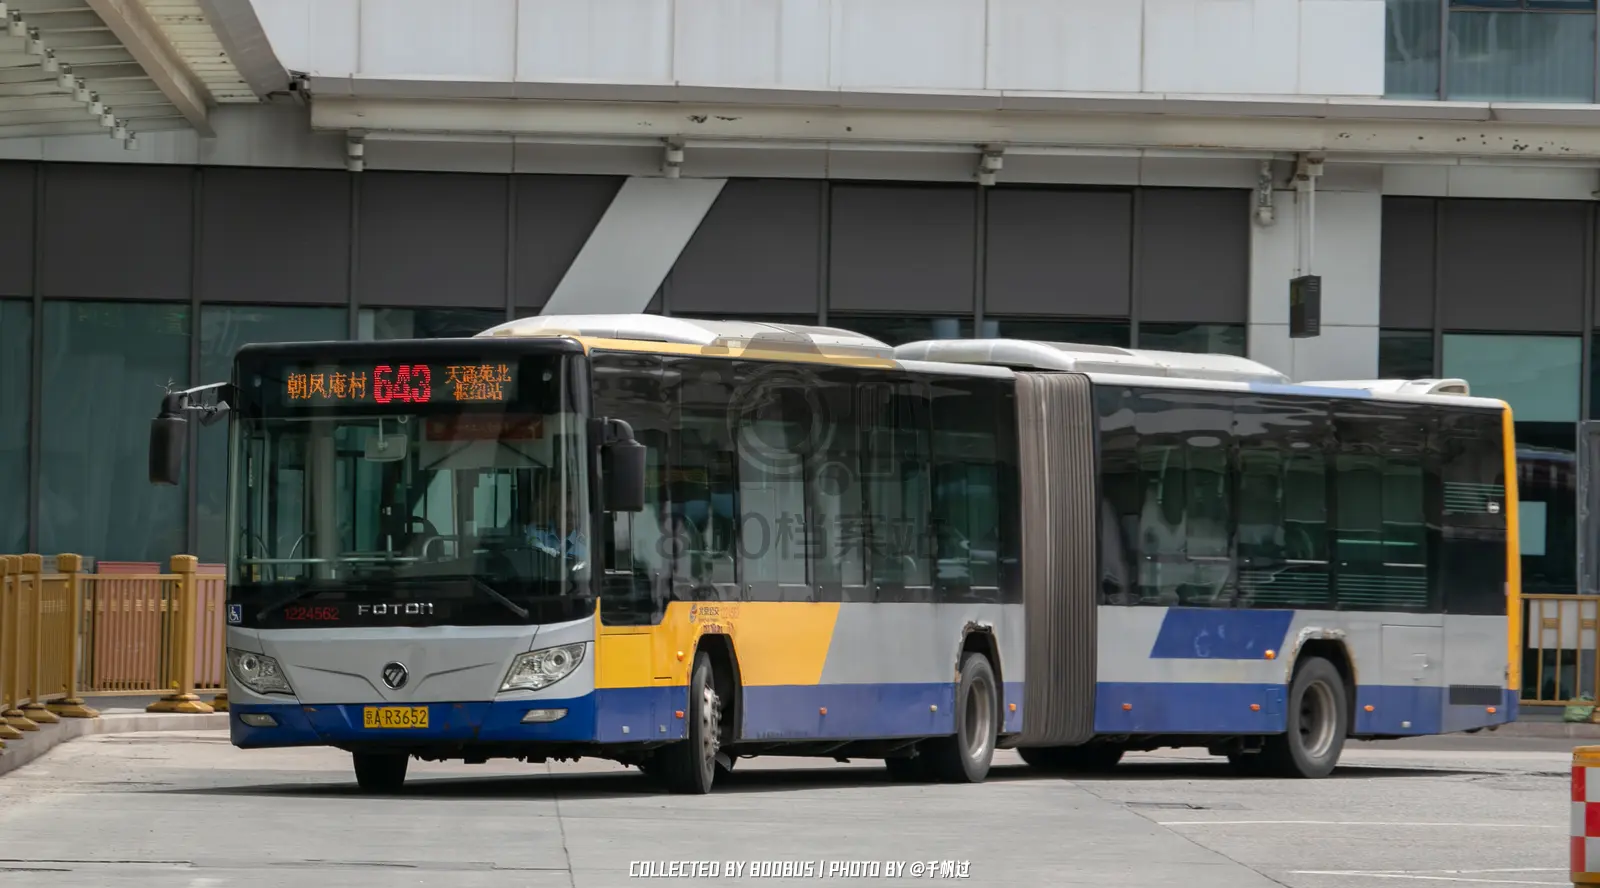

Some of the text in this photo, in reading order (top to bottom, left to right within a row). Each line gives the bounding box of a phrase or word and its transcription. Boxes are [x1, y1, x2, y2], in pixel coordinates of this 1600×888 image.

[287, 371, 367, 399] 朝凤庵村
[373, 364, 432, 404] 643
[284, 606, 341, 621] 1224562
[357, 601, 435, 616] FOTON
